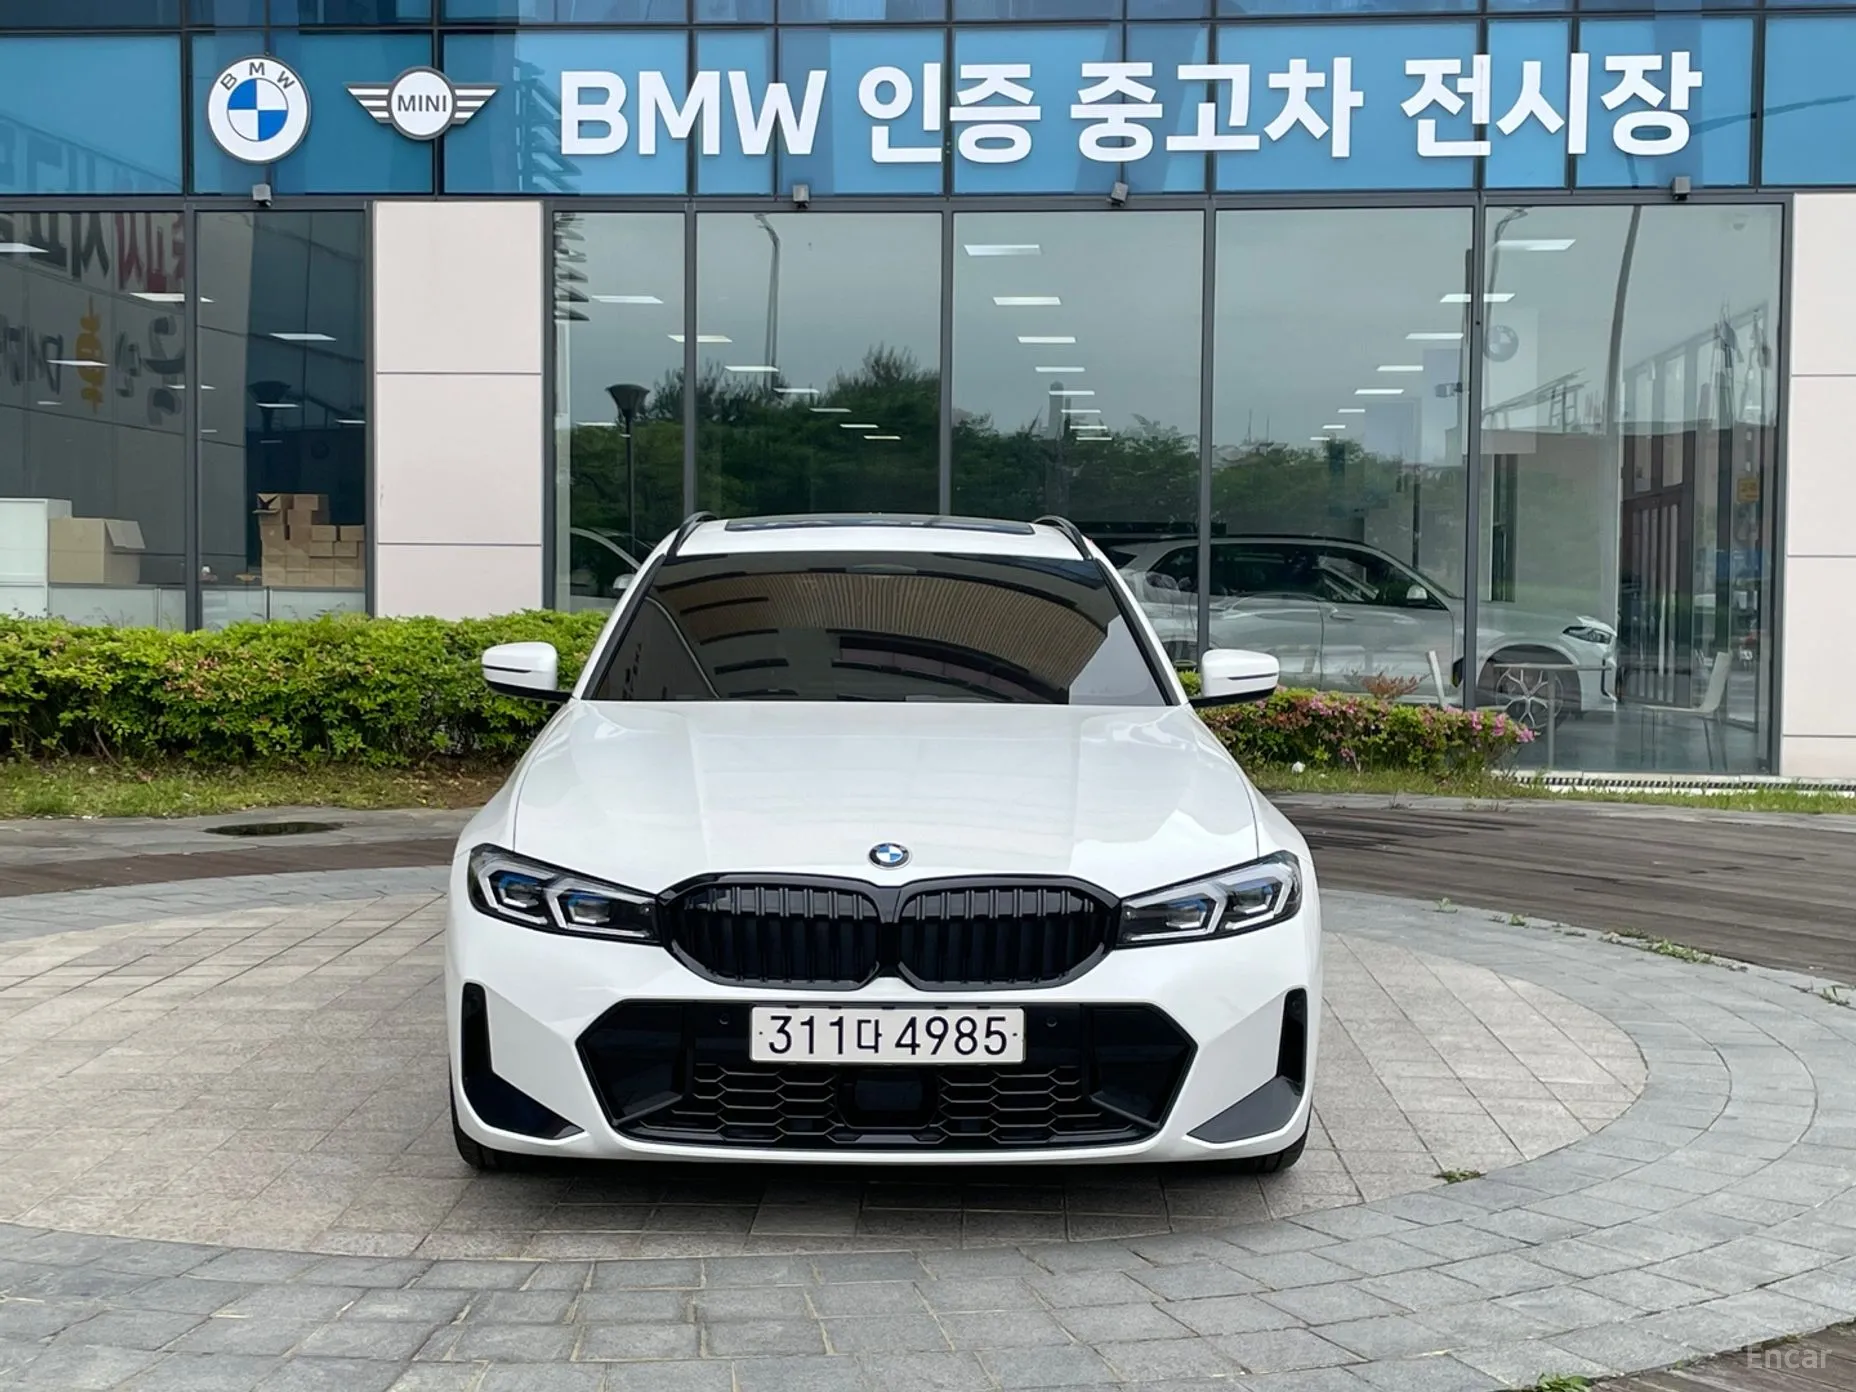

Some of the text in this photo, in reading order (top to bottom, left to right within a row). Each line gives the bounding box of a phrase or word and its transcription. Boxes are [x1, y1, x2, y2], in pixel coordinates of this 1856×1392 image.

[220, 61, 295, 92] BMW
[397, 94, 447, 113] MINI
[560, 51, 1703, 164] BMW 인증 중고차 전시장
[768, 1015, 1008, 1056] 311다4985
